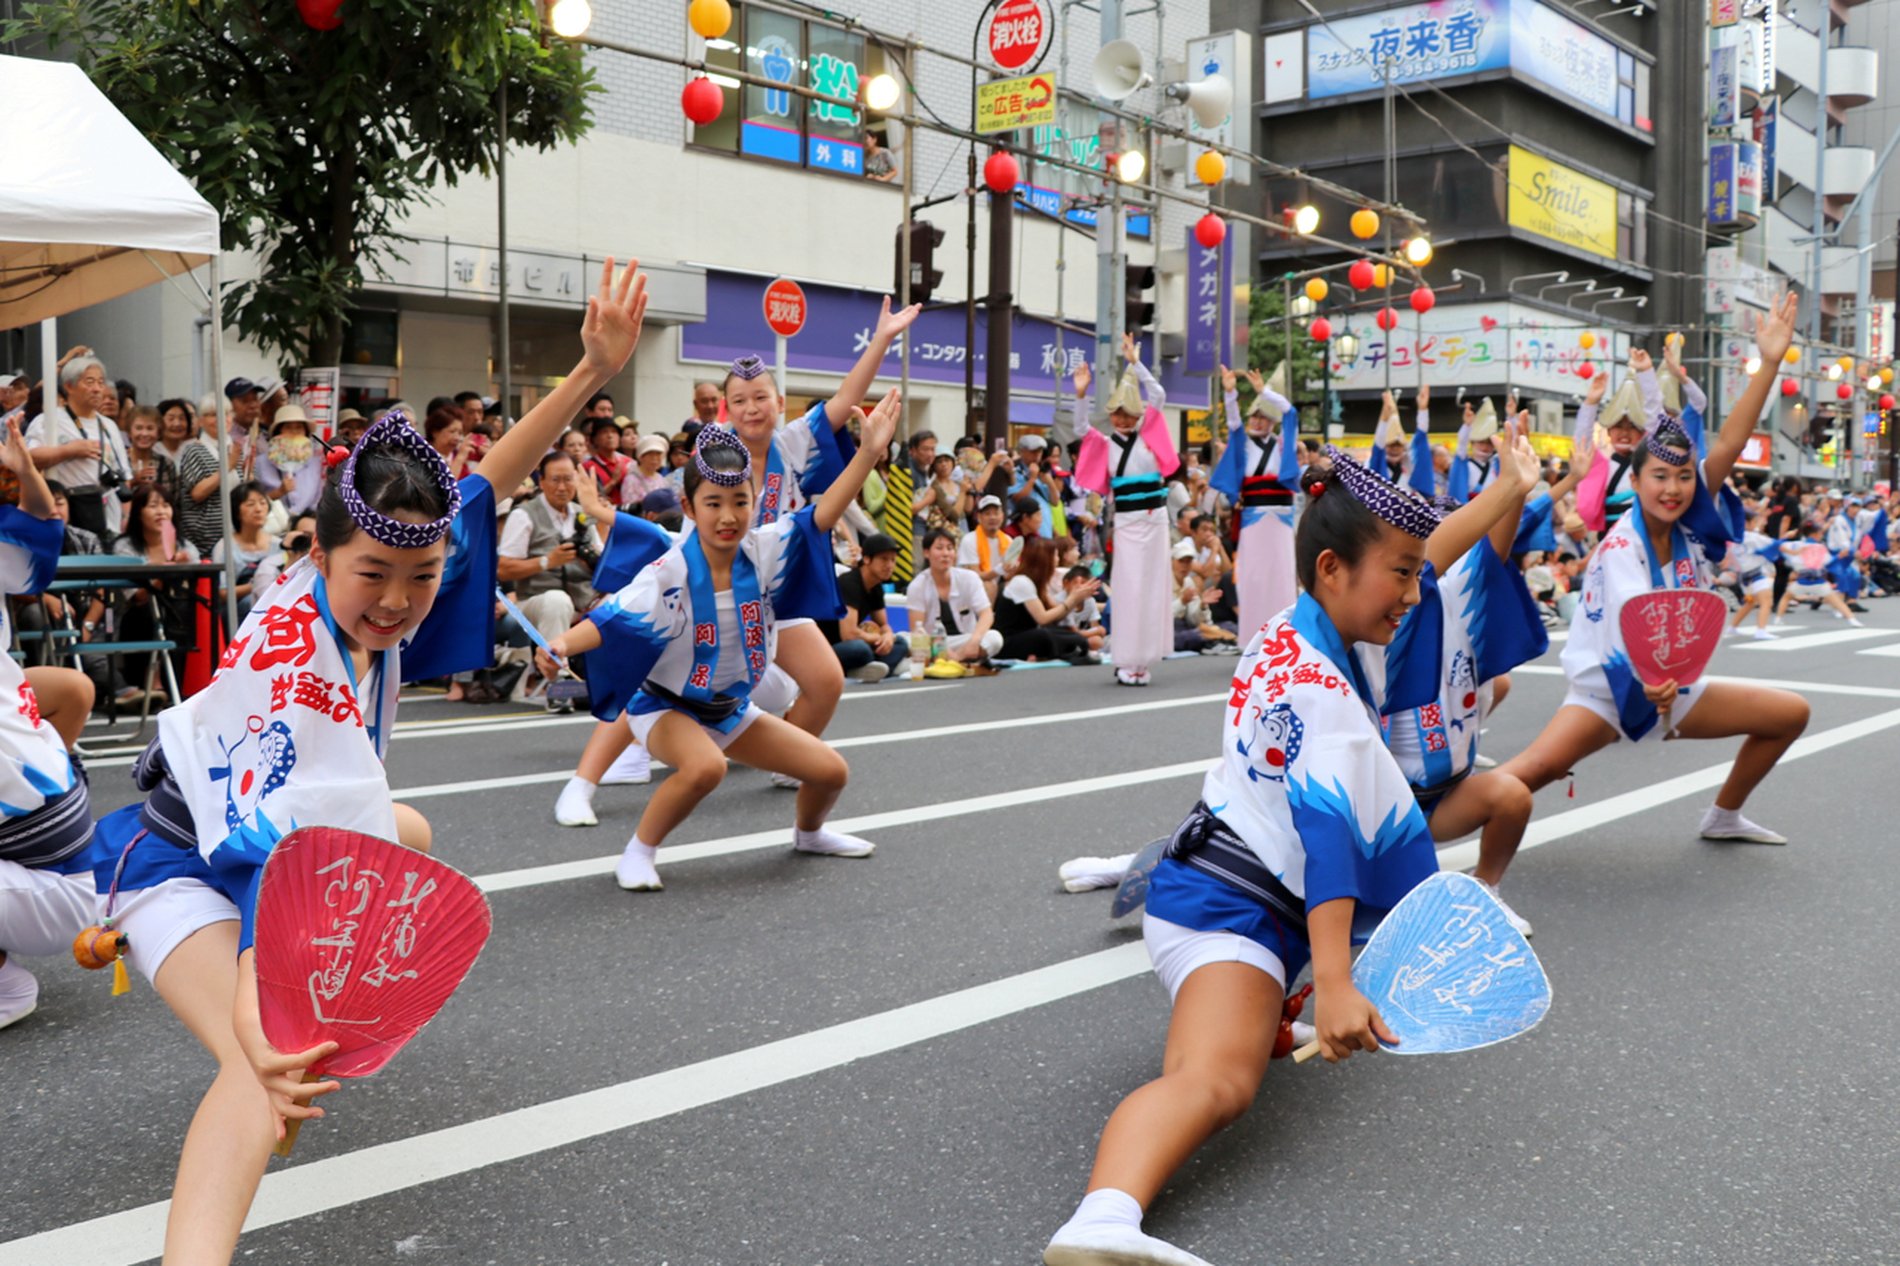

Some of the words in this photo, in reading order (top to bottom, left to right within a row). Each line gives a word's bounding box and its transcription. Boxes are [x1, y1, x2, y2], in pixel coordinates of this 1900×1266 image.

[992, 14, 1040, 51] 消火栓
[1369, 11, 1480, 66] 夜来香
[1370, 56, 1477, 82] 08-954-9618
[816, 143, 856, 169] 外科
